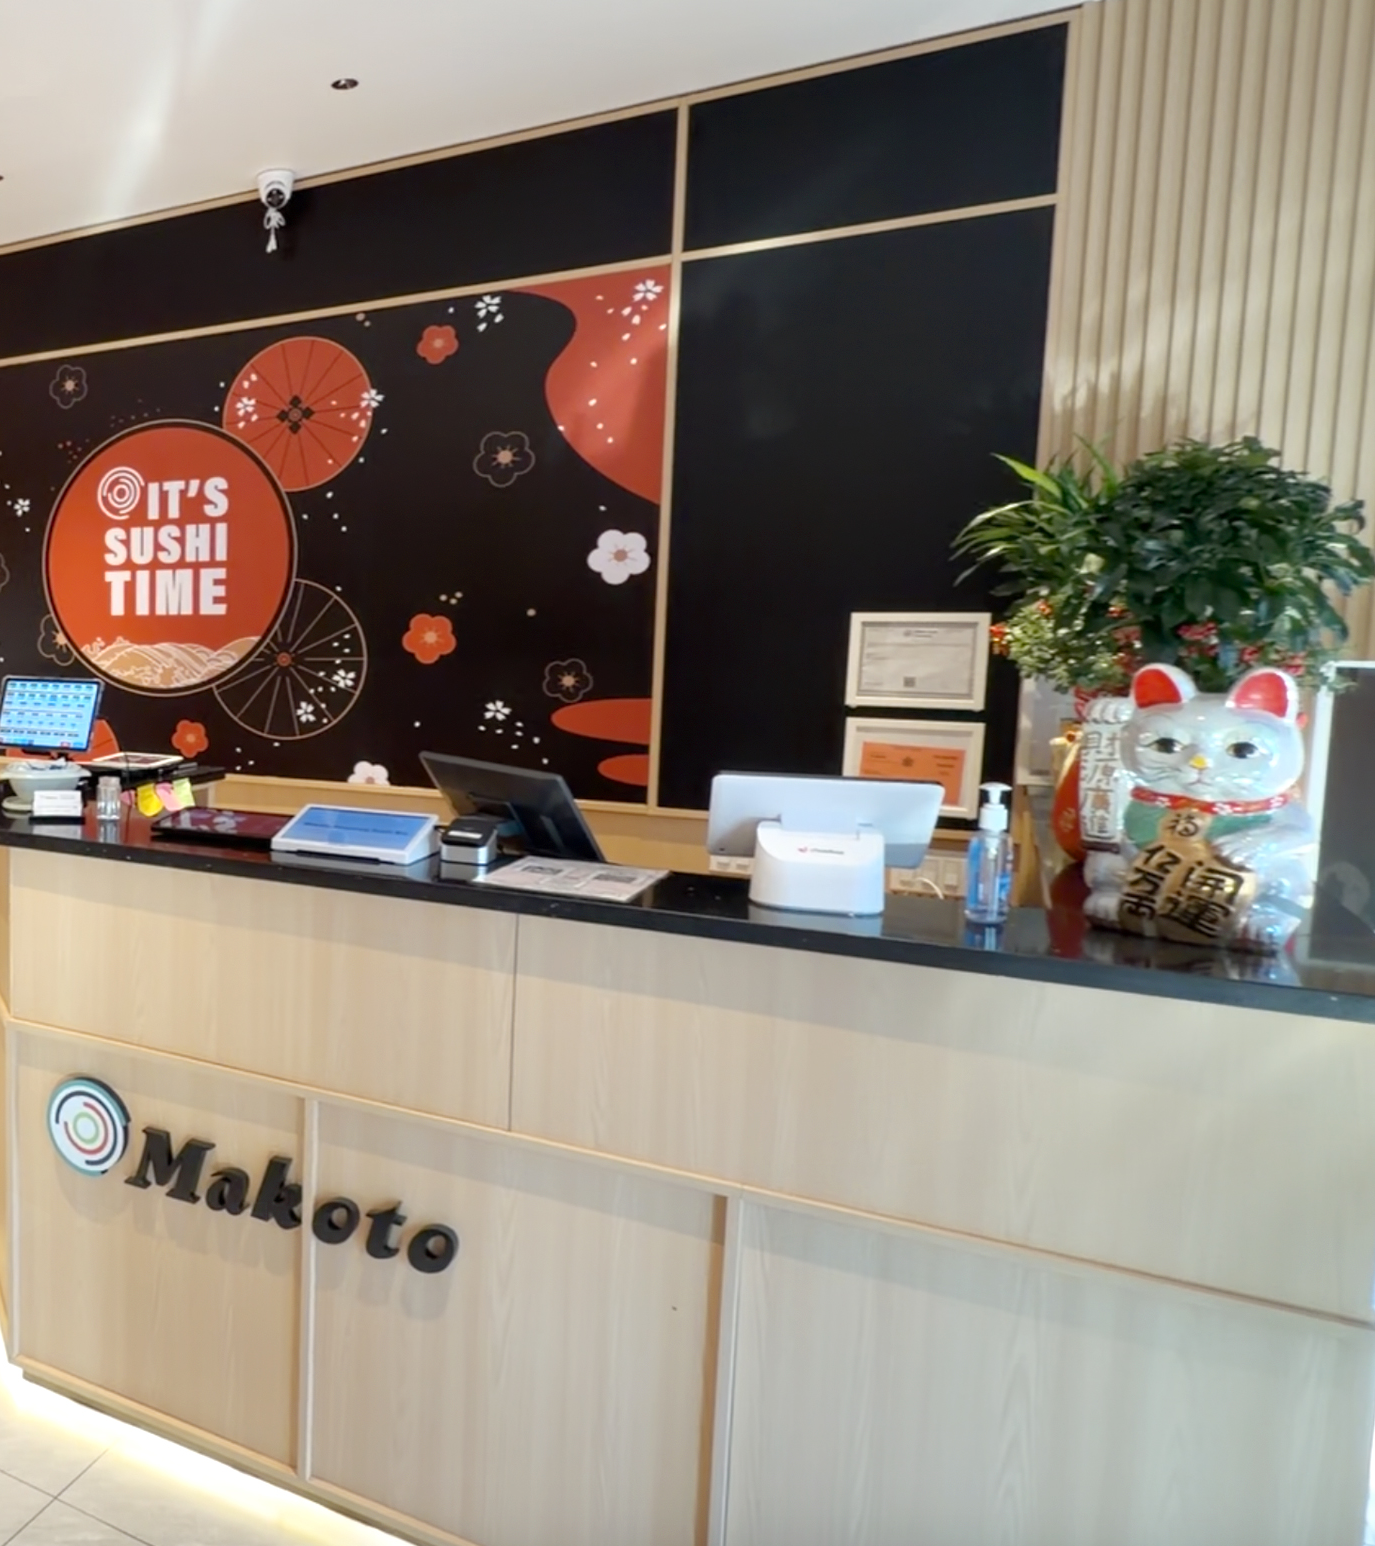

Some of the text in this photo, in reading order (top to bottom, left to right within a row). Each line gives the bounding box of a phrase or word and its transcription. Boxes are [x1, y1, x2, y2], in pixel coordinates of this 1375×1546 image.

[147, 476, 229, 520] IT'S
[104, 522, 228, 566] SUSHI
[104, 567, 227, 617] TIME
[124, 1126, 460, 1273] Makoto
